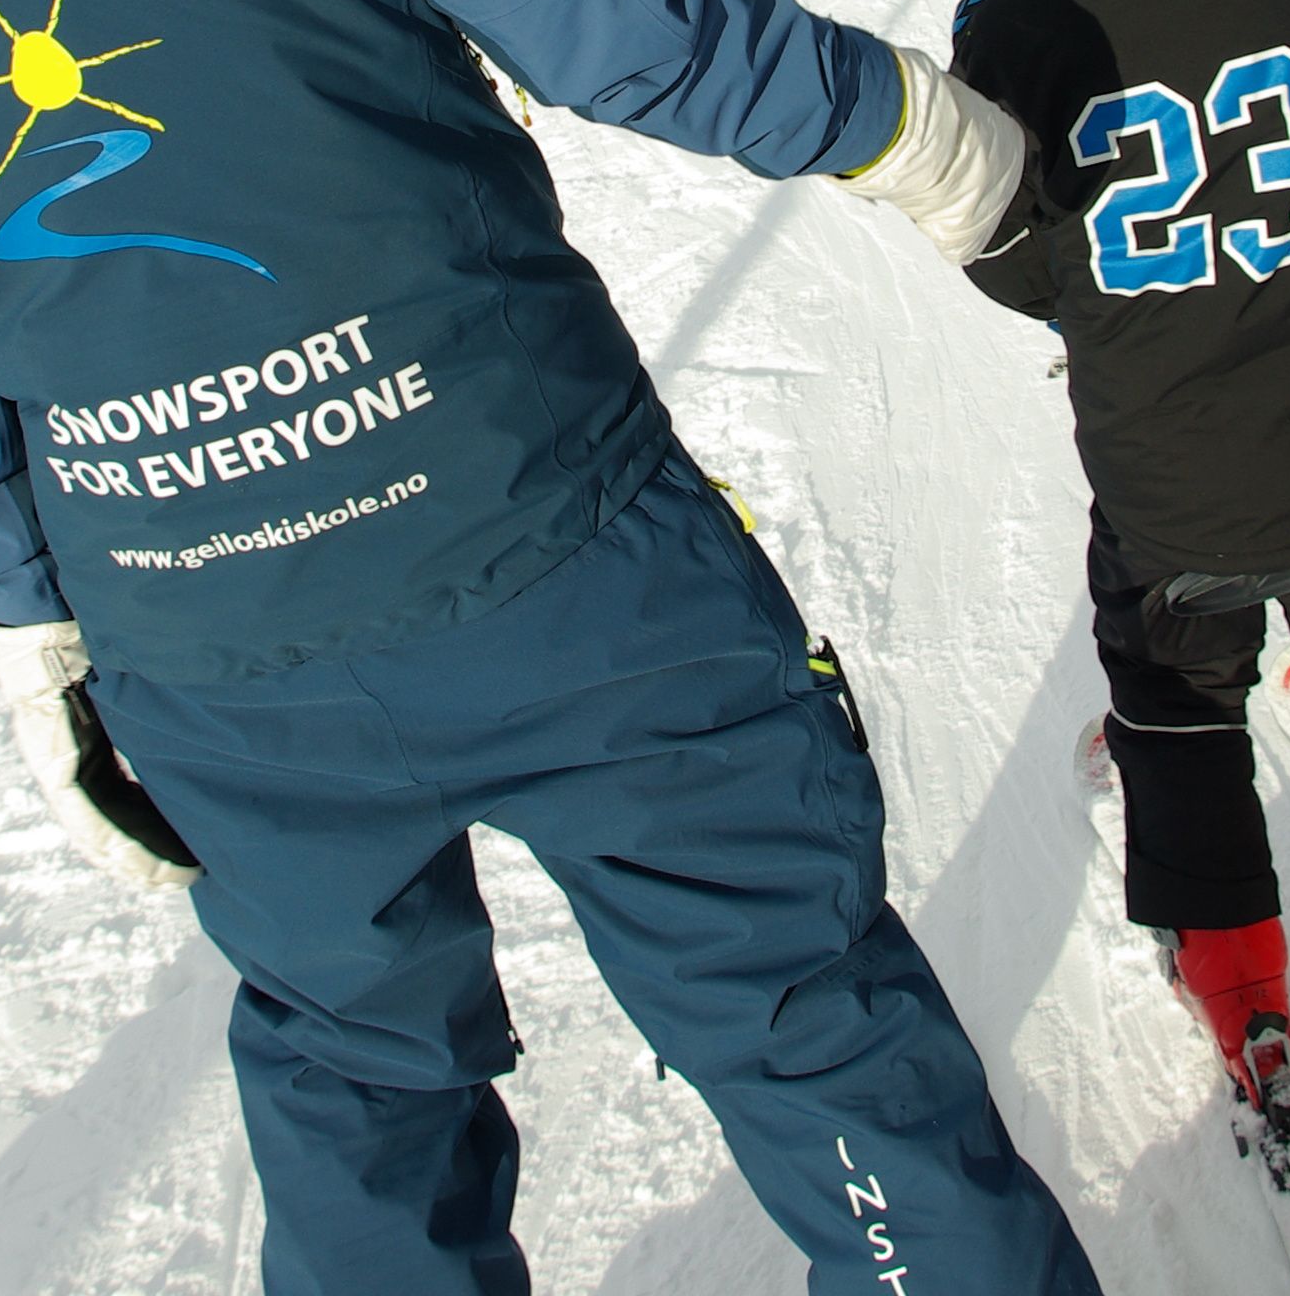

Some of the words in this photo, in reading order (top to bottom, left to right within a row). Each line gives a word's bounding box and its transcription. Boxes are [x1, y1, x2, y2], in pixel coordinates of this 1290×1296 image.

[46, 314, 374, 446] SNOWSPORT
[46, 456, 143, 497] FOR
[137, 361, 435, 499] EVERYONE
[109, 472, 429, 570] www.geiloskiskole.no
[837, 1136, 908, 1296] INST
